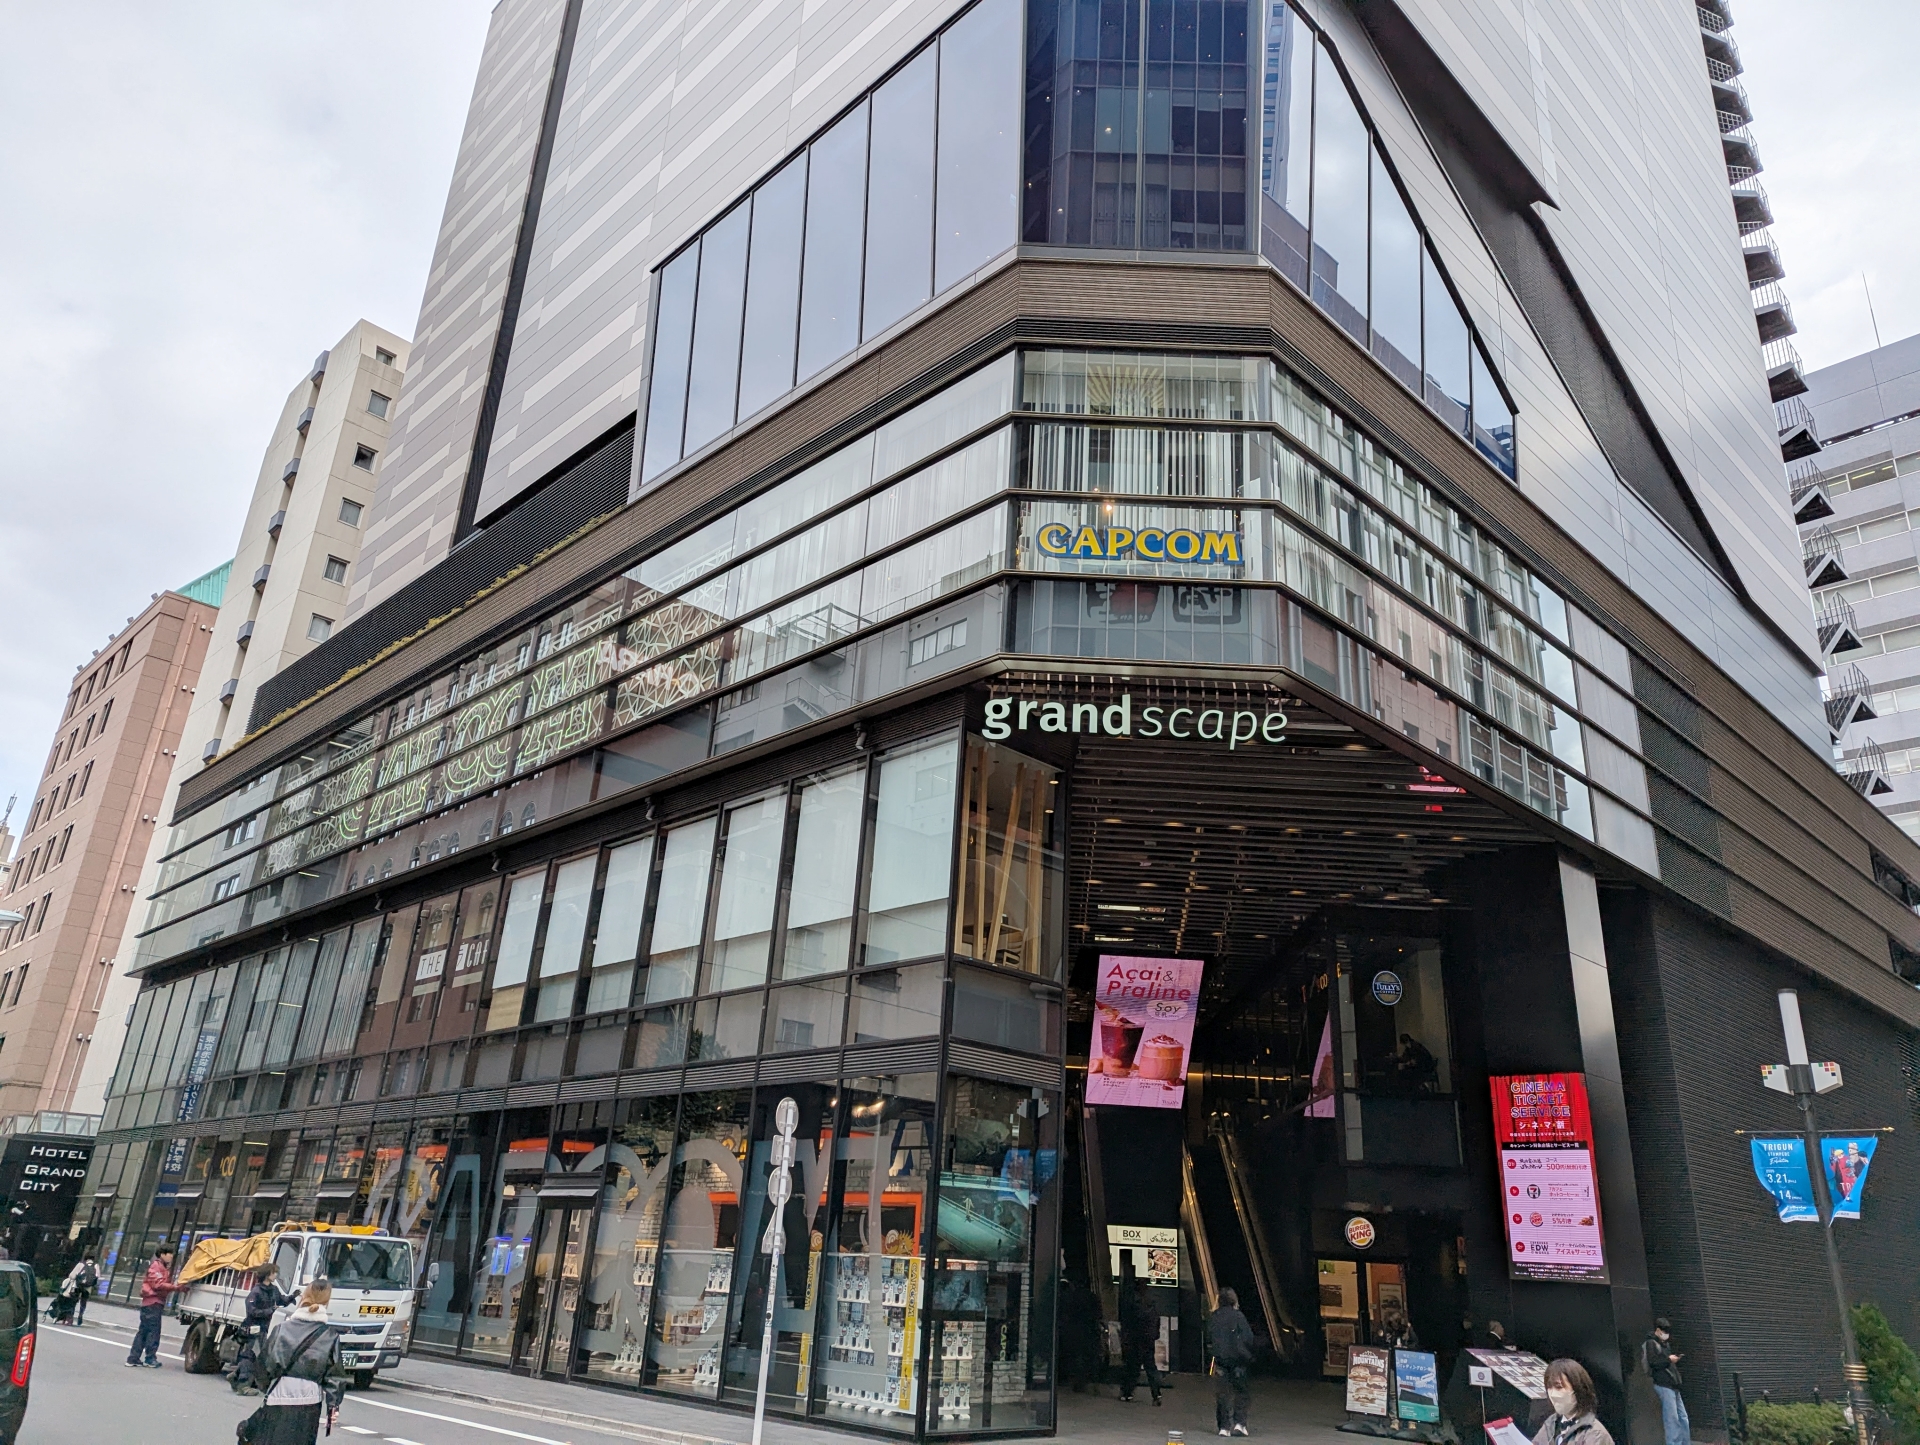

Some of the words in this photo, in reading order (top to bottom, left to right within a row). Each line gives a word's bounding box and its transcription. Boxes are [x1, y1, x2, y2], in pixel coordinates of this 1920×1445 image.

[1037, 522, 1243, 564] CAPCOM
[419, 953, 442, 976] THE
[1106, 963, 1162, 984] Açai
[1162, 970, 1174, 982] &
[1106, 980, 1191, 1001] Praline
[1154, 1002, 1181, 1015] Soy
[1510, 1082, 1566, 1093] CINEMA
[1514, 1093, 1563, 1105] TICKET
[1511, 1105, 1571, 1118] SERVICE
[30, 1145, 88, 1160] HOTEL
[1762, 1143, 1793, 1151] TRIGUN
[24, 1164, 86, 1178] GRAND
[1767, 1173, 1788, 1184] 3.21
[19, 1180, 62, 1192] CITY
[1122, 1229, 1142, 1239] BOX
[1349, 1224, 1371, 1234] BURGER
[1350, 1230, 1372, 1241] KING
[1530, 1244, 1549, 1252] EDW
[805, 1256, 815, 1308] CAPCOM
[907, 1262, 917, 1317] CAPCOM
[360, 1305, 395, 1314] 高圧ガス
